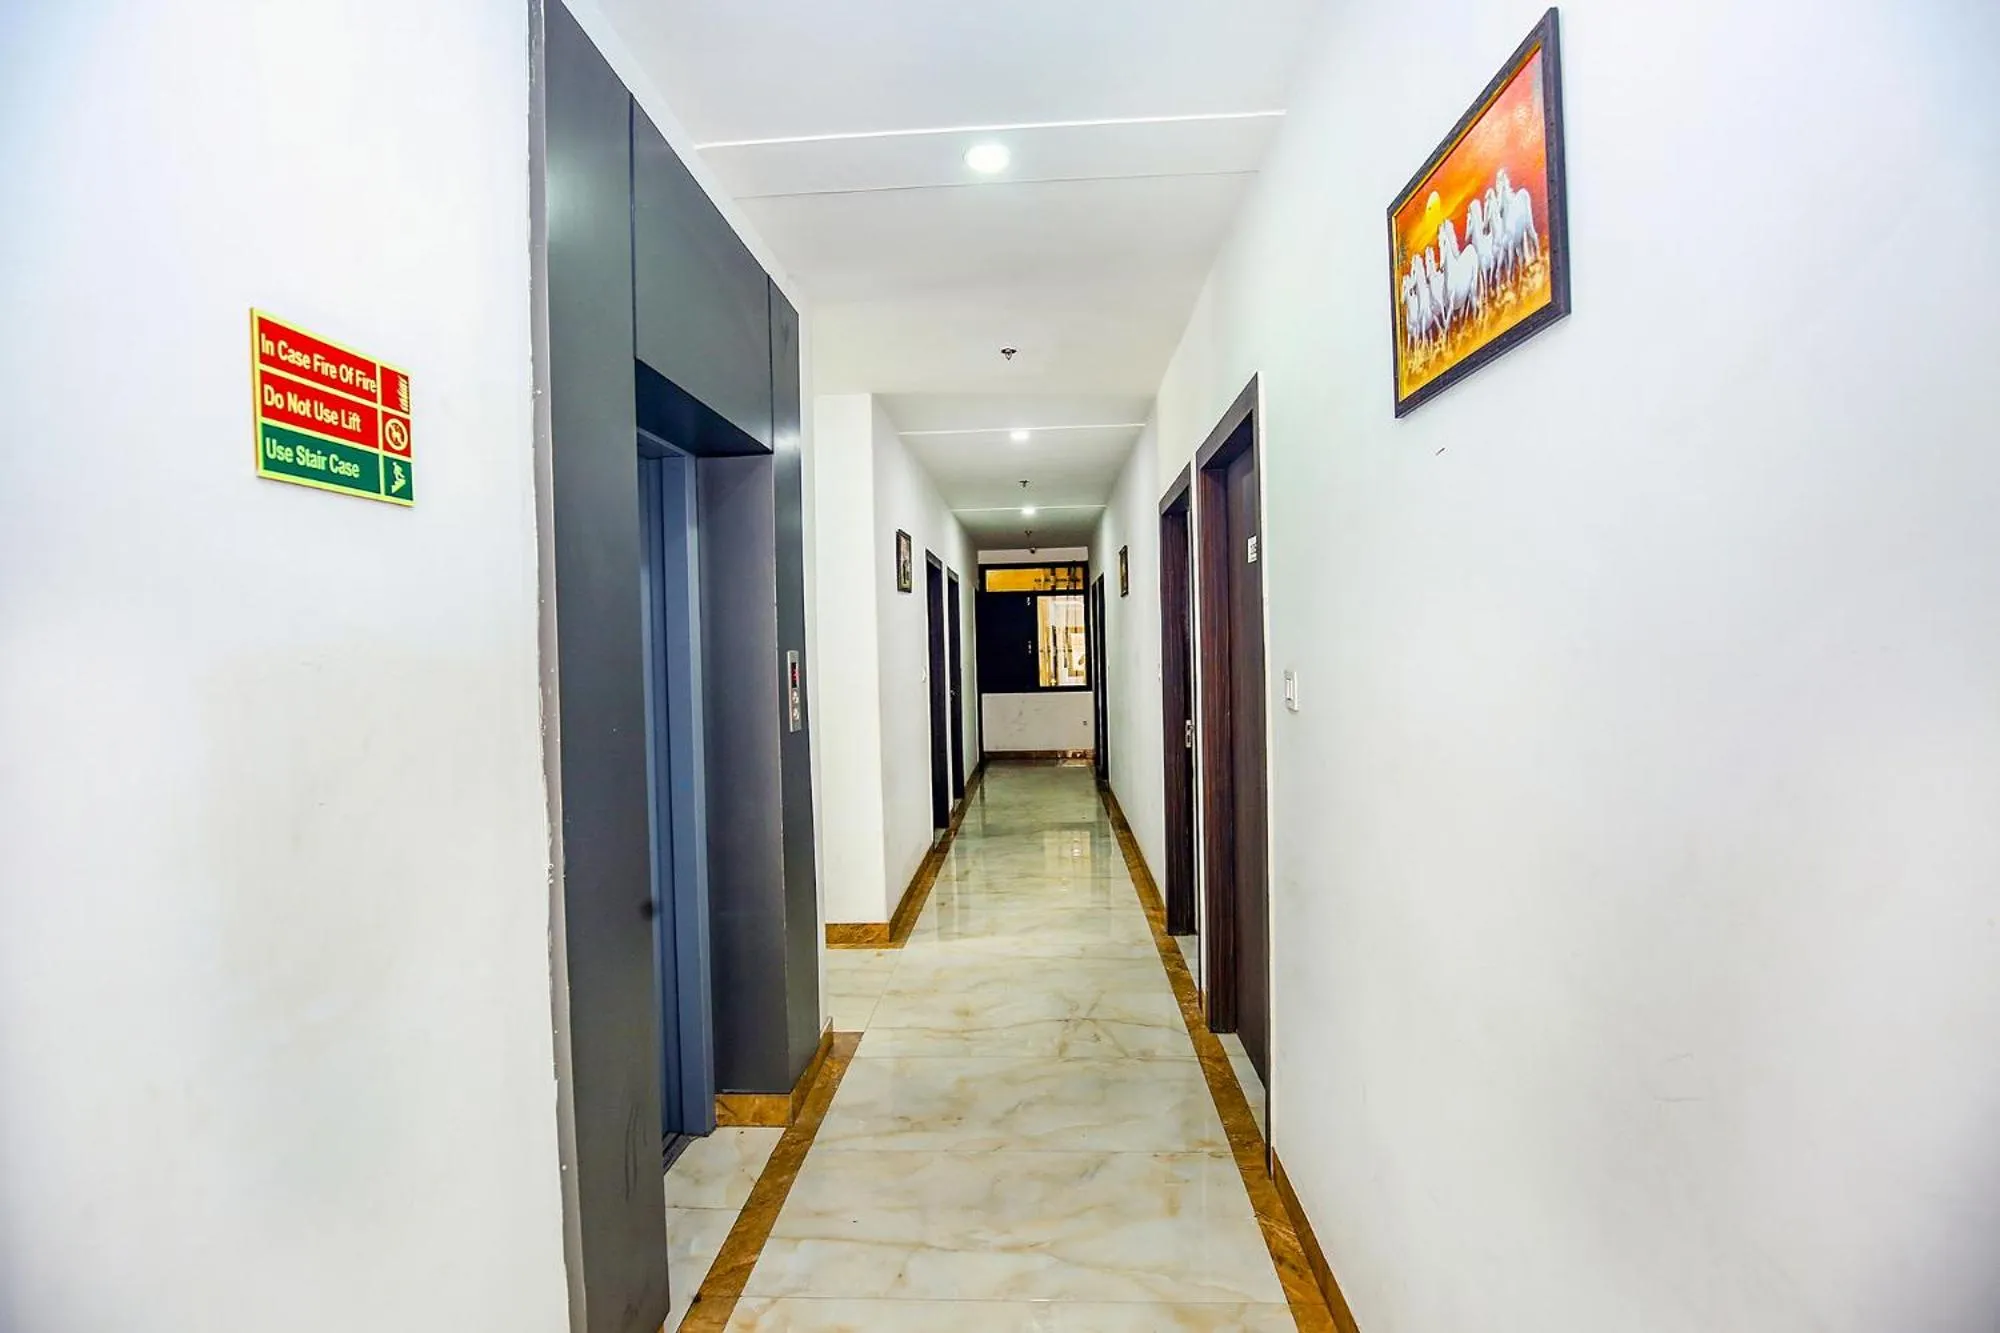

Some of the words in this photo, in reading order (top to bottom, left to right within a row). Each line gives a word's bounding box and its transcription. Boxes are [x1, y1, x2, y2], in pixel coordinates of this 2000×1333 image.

[261, 333, 274, 356] In
[277, 340, 310, 370] Case
[313, 354, 337, 379] Fire
[339, 362, 354, 385] Of
[356, 369, 377, 394] Fire
[264, 384, 284, 409] Do
[287, 391, 312, 418] Not
[315, 401, 338, 426] Use
[342, 411, 362, 433] Lift
[265, 437, 294, 464] Use
[296, 445, 327, 472] Stair
[329, 455, 360, 478] Case
